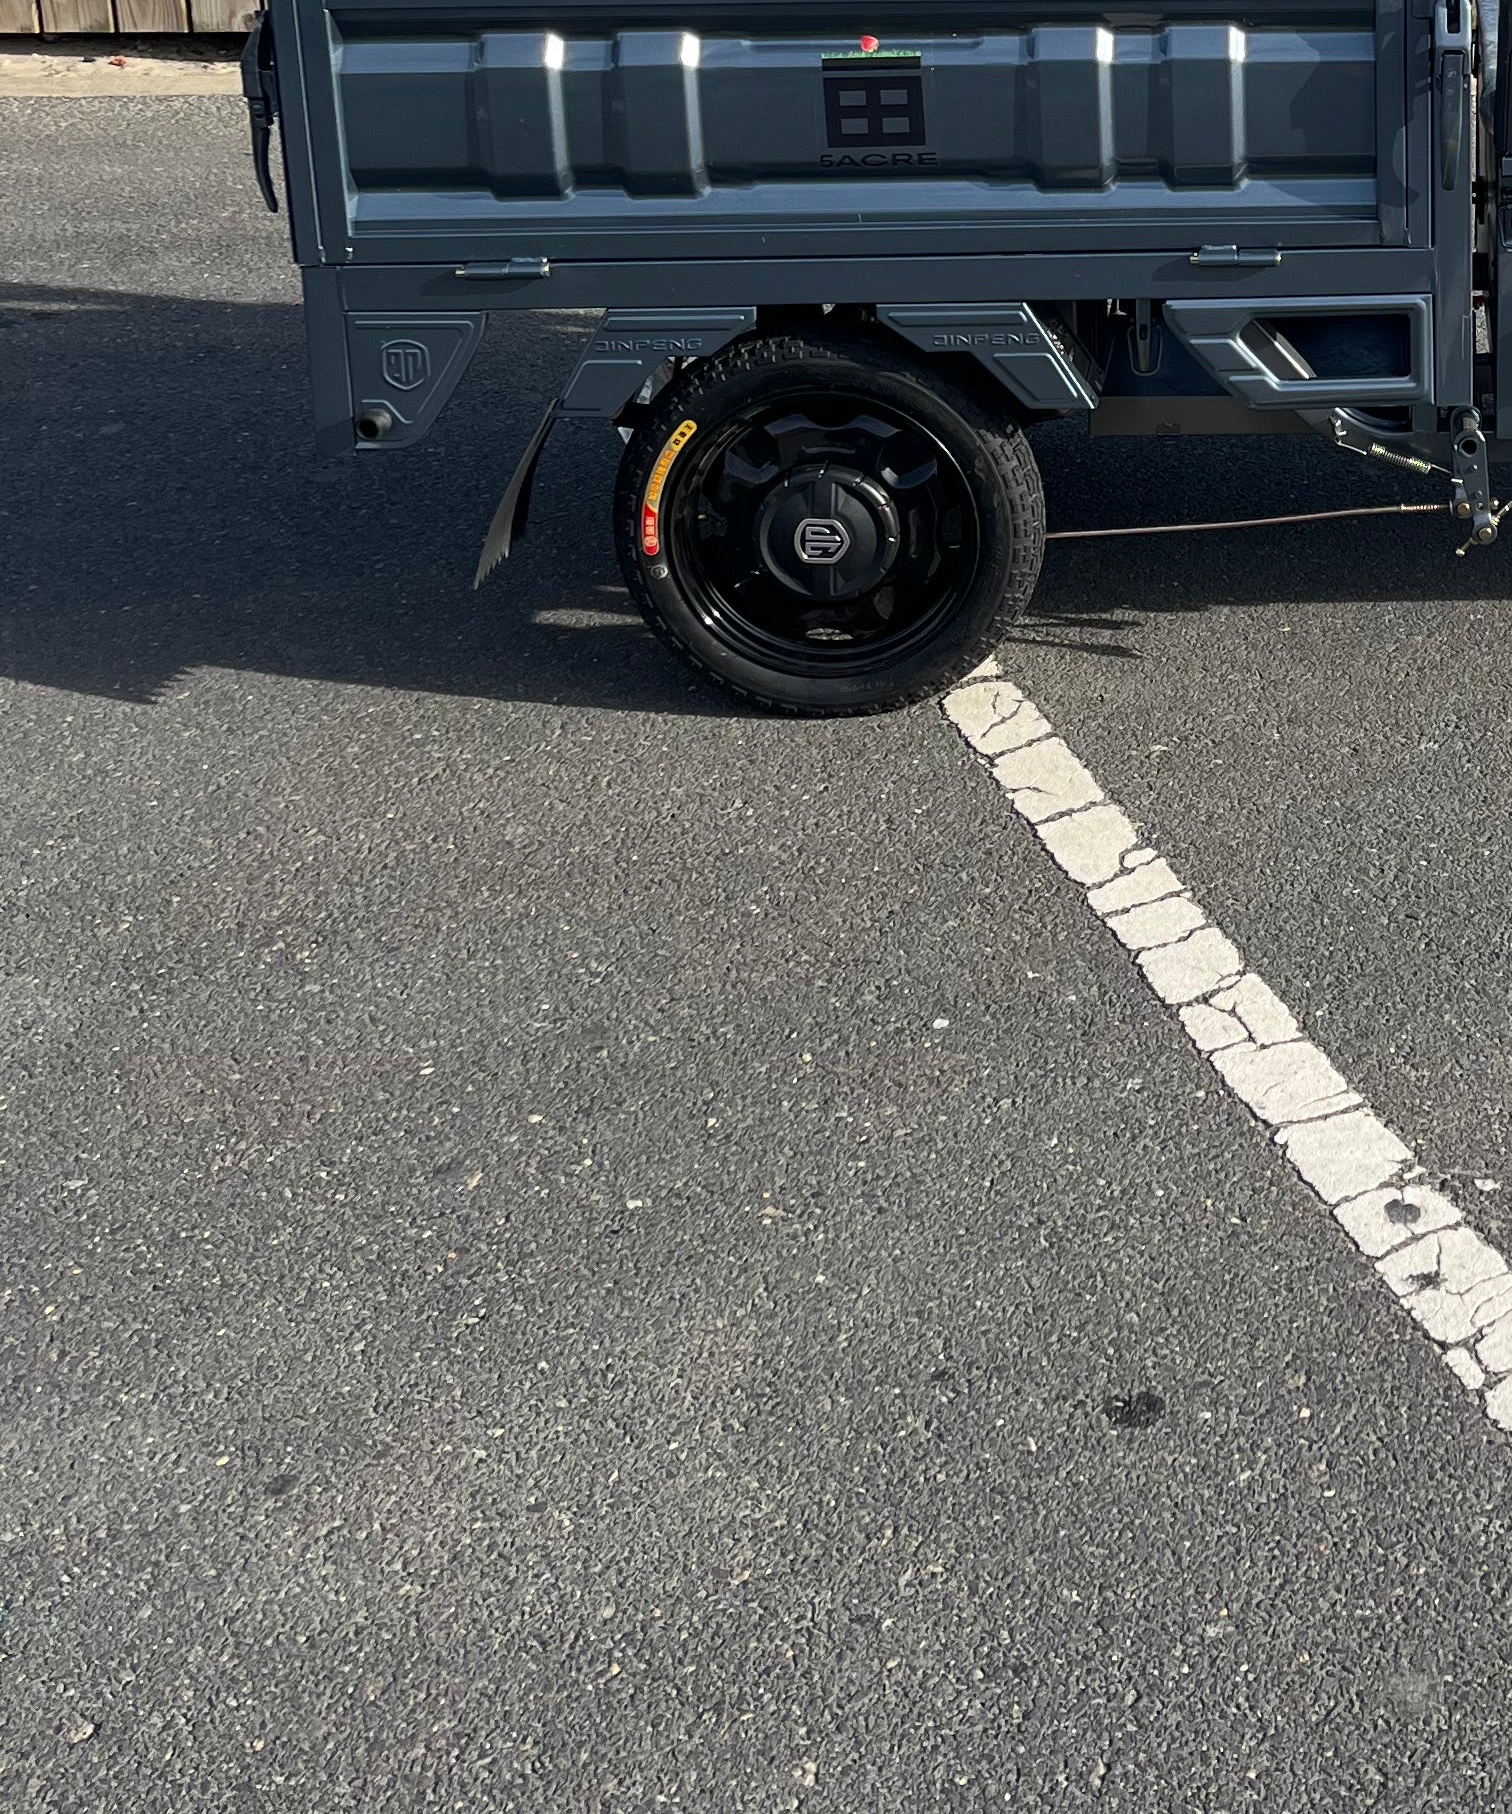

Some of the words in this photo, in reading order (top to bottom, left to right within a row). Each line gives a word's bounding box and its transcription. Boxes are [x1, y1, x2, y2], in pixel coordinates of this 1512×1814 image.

[820, 152, 937, 167] 5ACRE
[595, 338, 702, 352] JINPENG
[932, 333, 1040, 346] JINPENG
